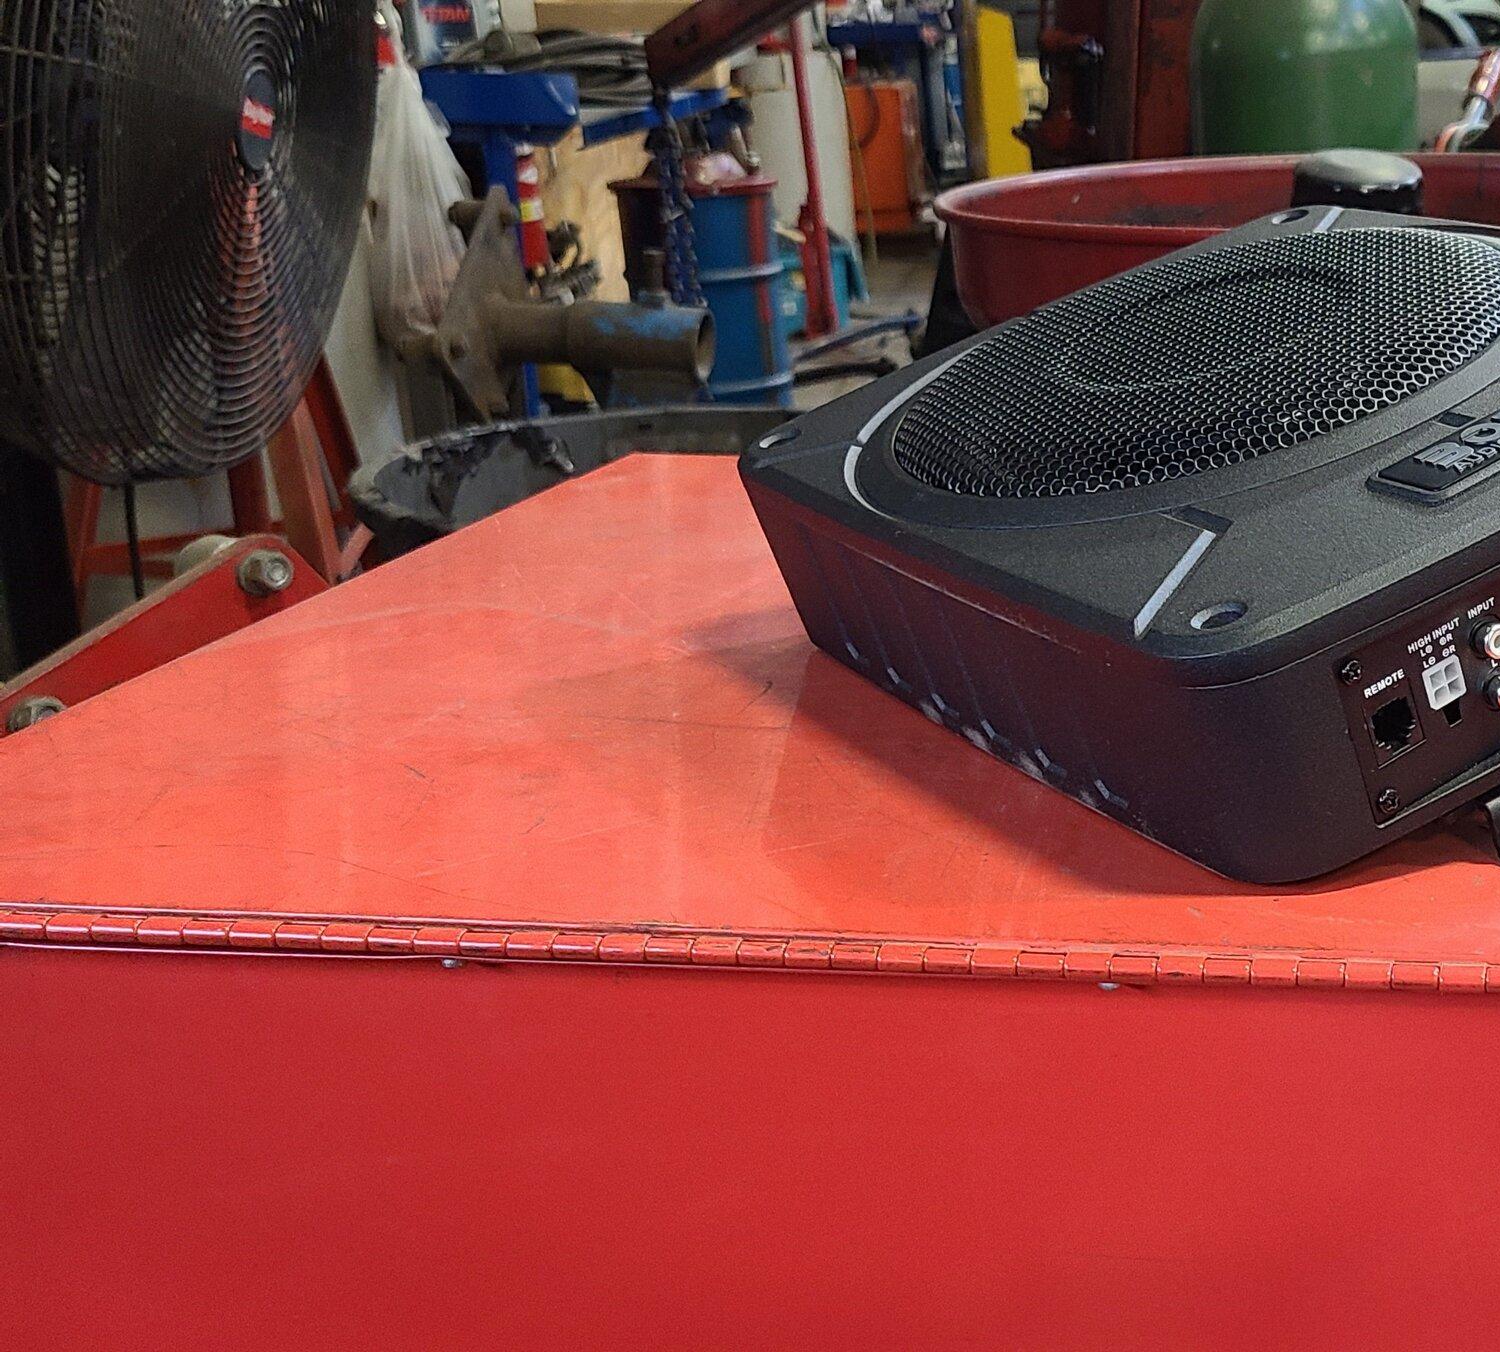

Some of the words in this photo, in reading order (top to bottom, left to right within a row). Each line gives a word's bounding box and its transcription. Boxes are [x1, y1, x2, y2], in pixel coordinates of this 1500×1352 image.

[1467, 597, 1495, 619] INPUT
[1407, 633, 1431, 654] HIGH
[1431, 617, 1461, 640] INPUT
[1491, 658, 1499, 668] L
[1363, 669, 1405, 698] REMOTE
